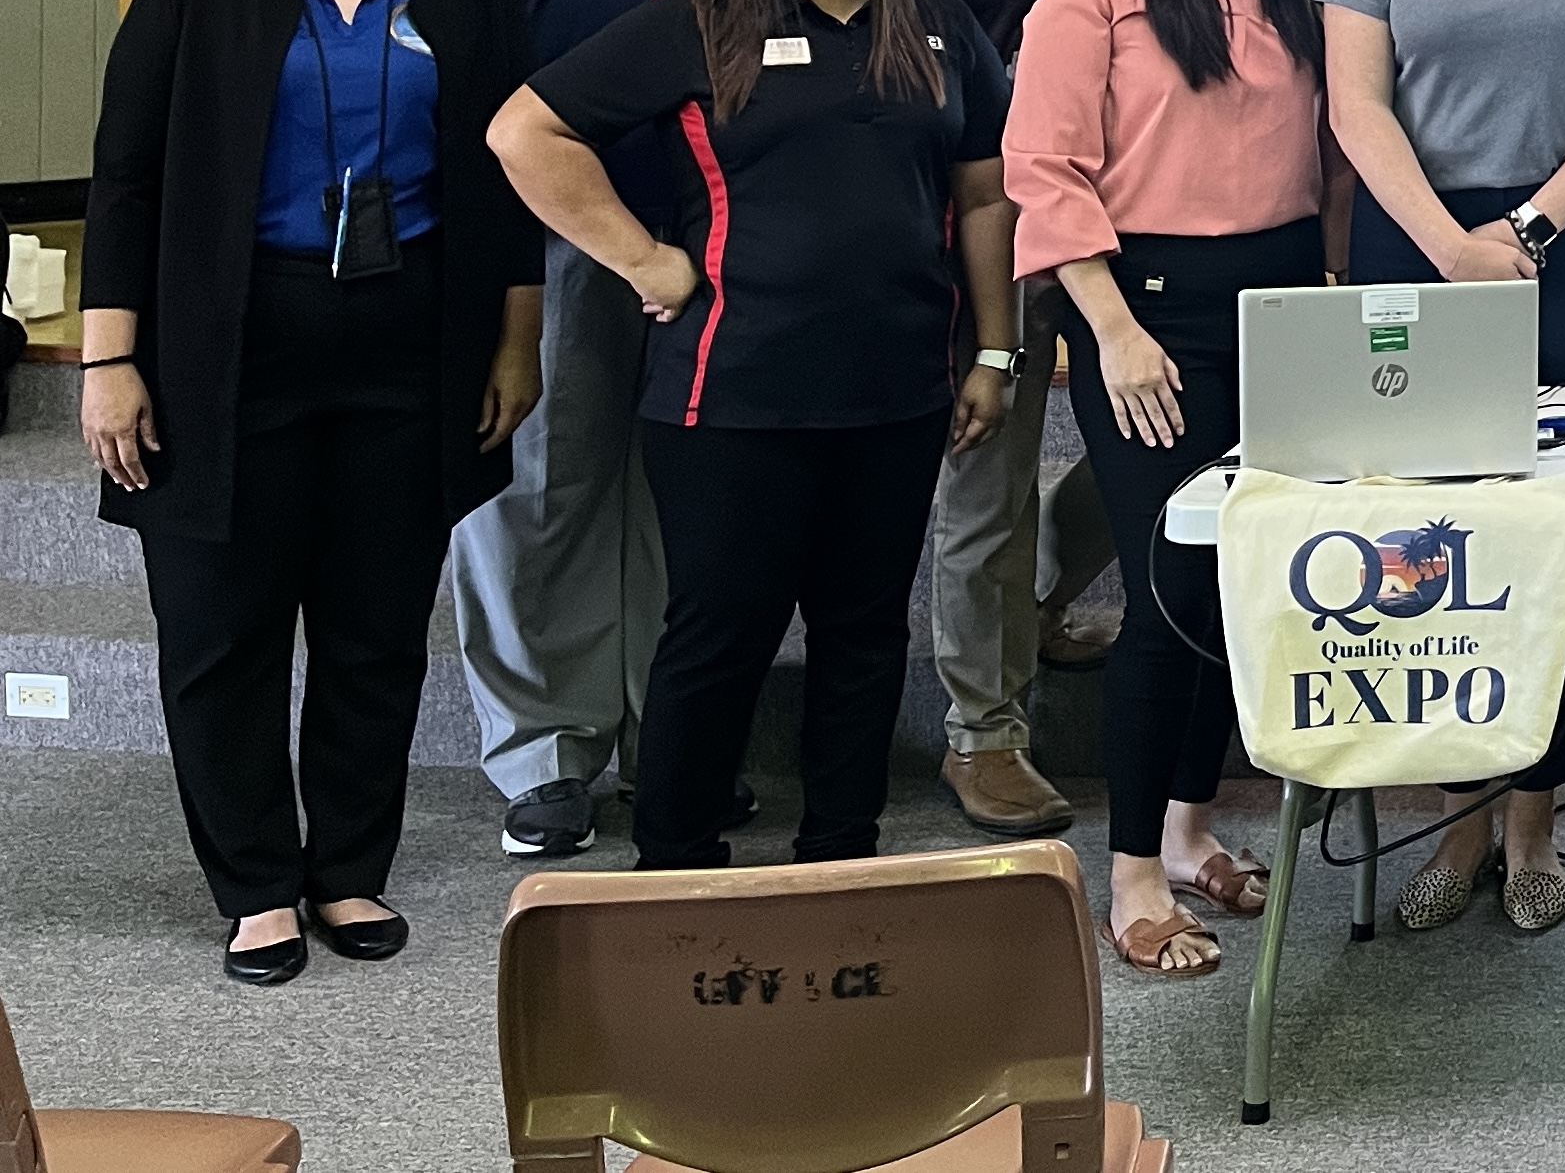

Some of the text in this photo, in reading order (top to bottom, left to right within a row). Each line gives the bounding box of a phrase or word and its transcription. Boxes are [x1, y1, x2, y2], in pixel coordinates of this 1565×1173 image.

[1374, 363, 1407, 399] hp
[1289, 529, 1511, 636] QOL
[1321, 635, 1480, 663] Quality of Life
[1290, 665, 1506, 730] EXPO
